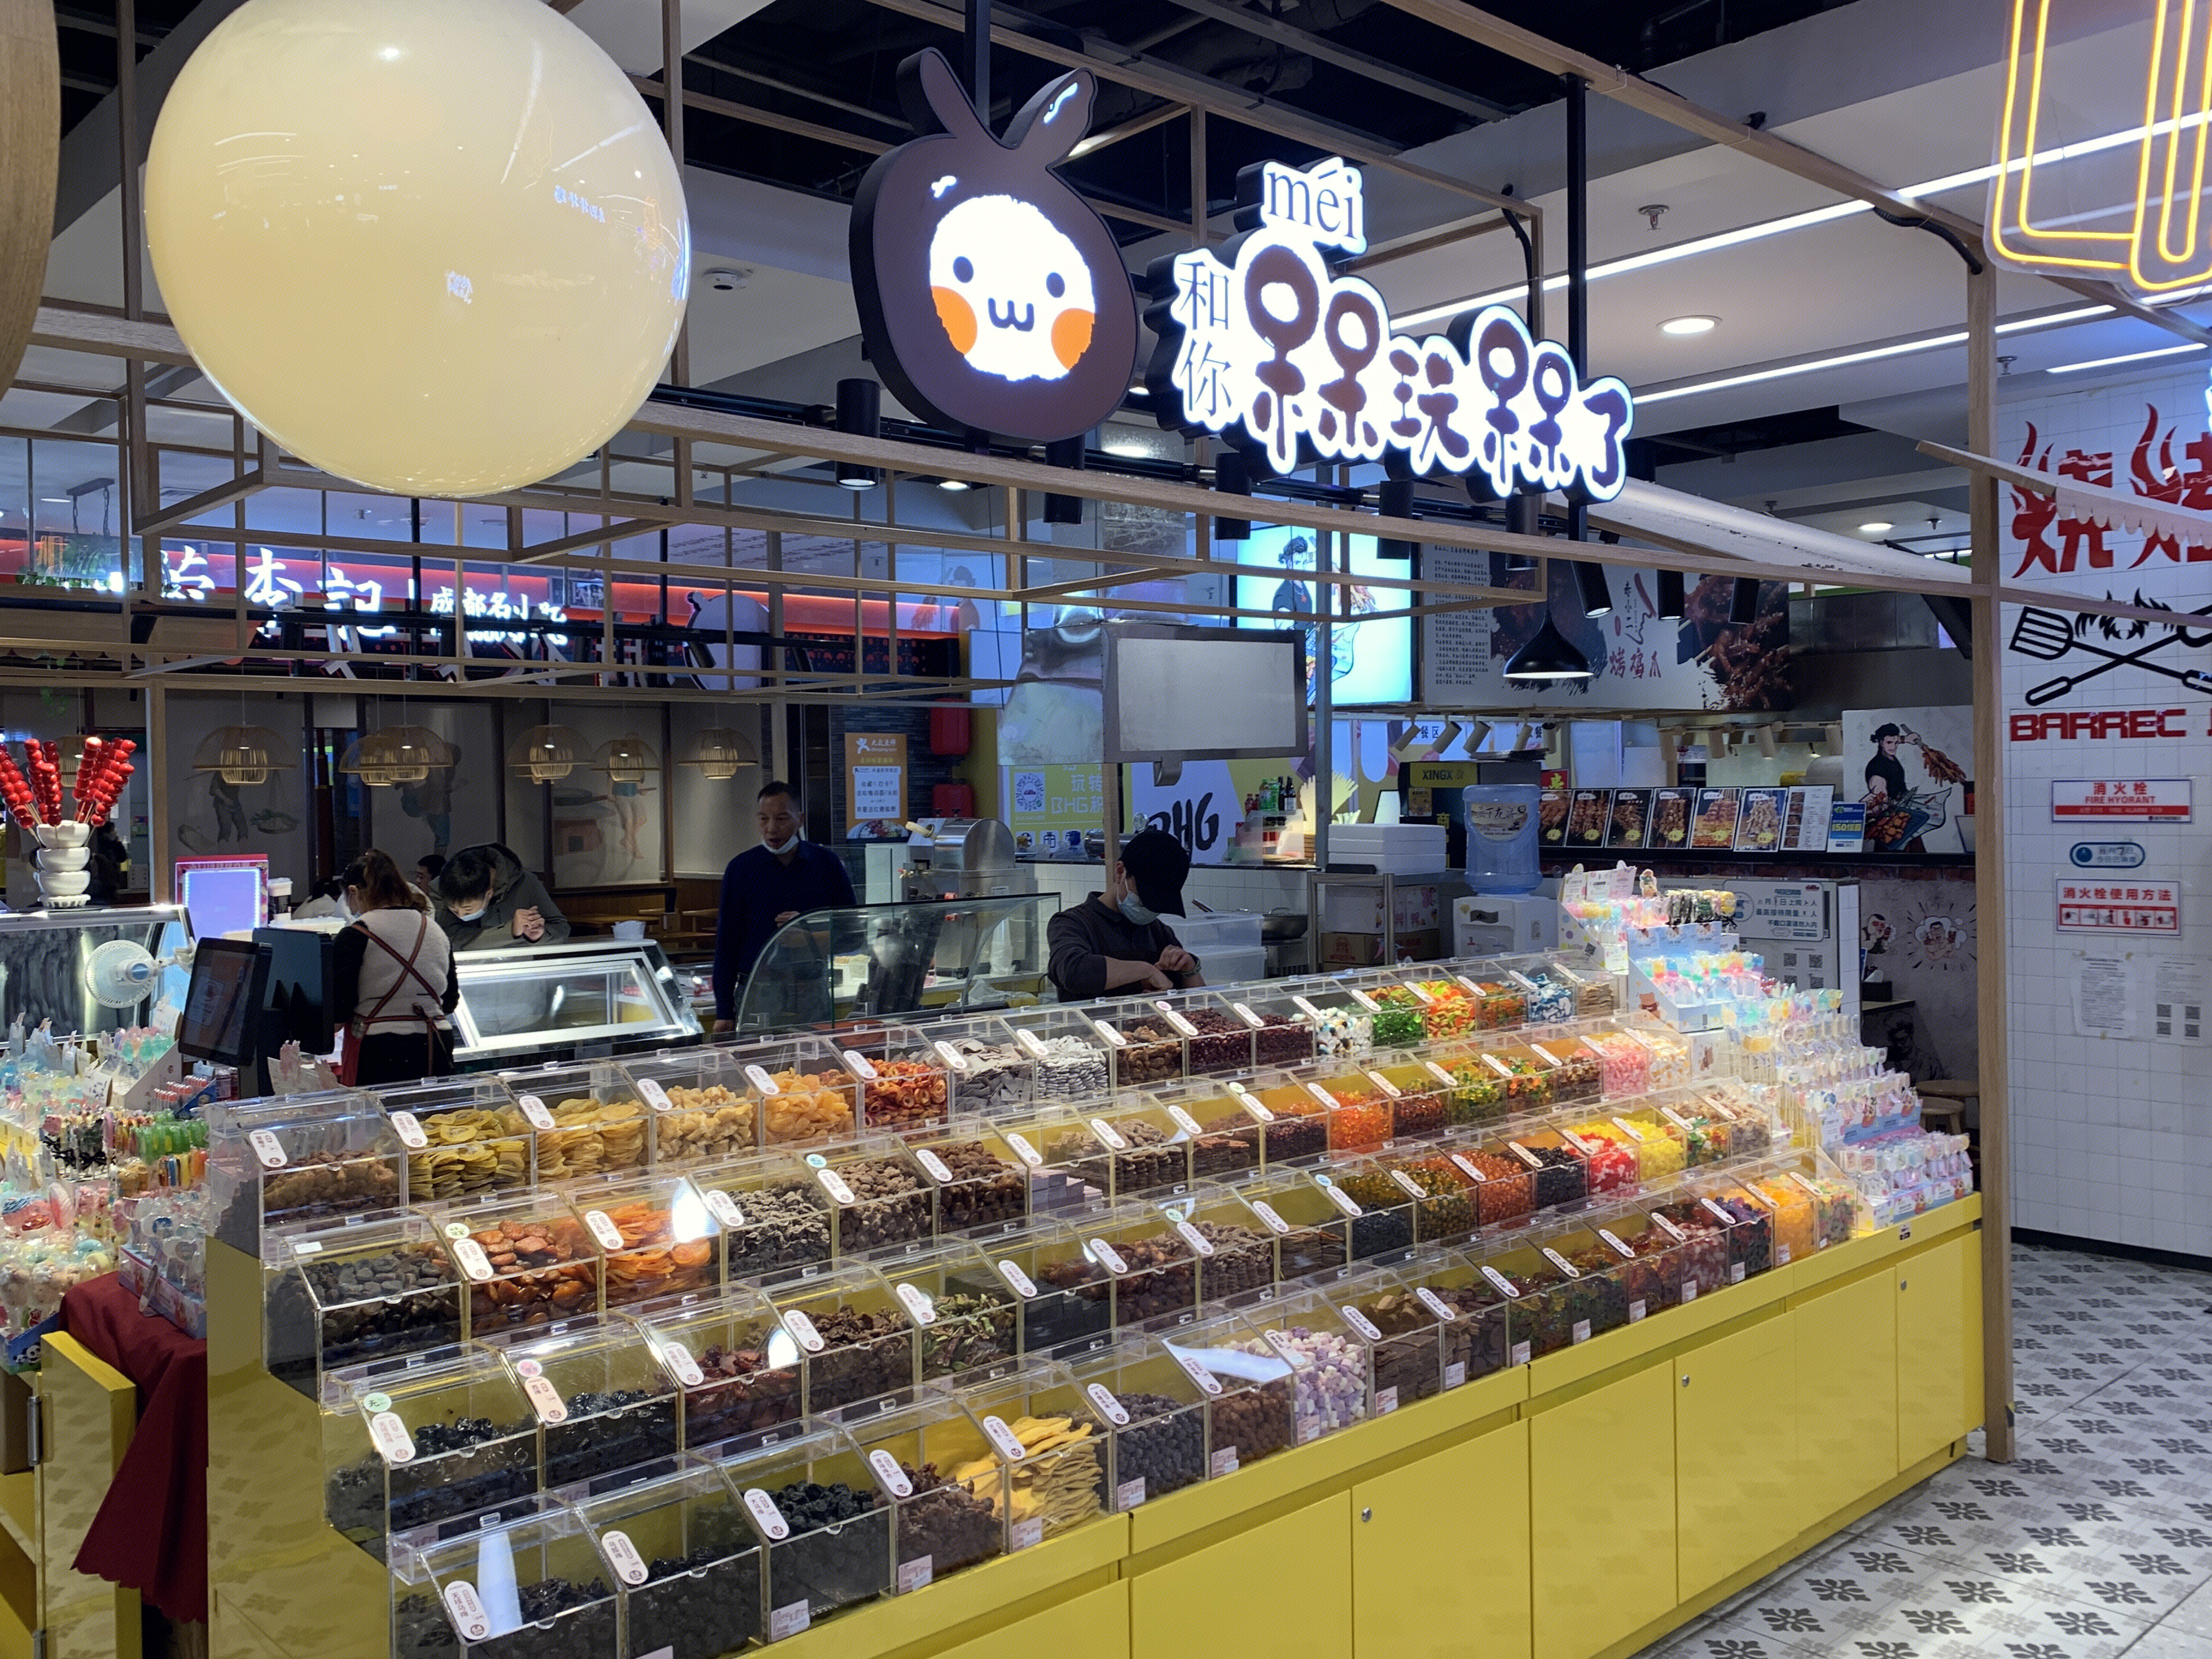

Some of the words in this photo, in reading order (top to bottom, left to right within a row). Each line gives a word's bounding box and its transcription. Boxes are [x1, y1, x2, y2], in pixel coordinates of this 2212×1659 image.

[2093, 781, 2148, 796] 消火栓
[2085, 795, 2106, 804] FIRE
[2063, 887, 2172, 901] 消火栓使用方法
